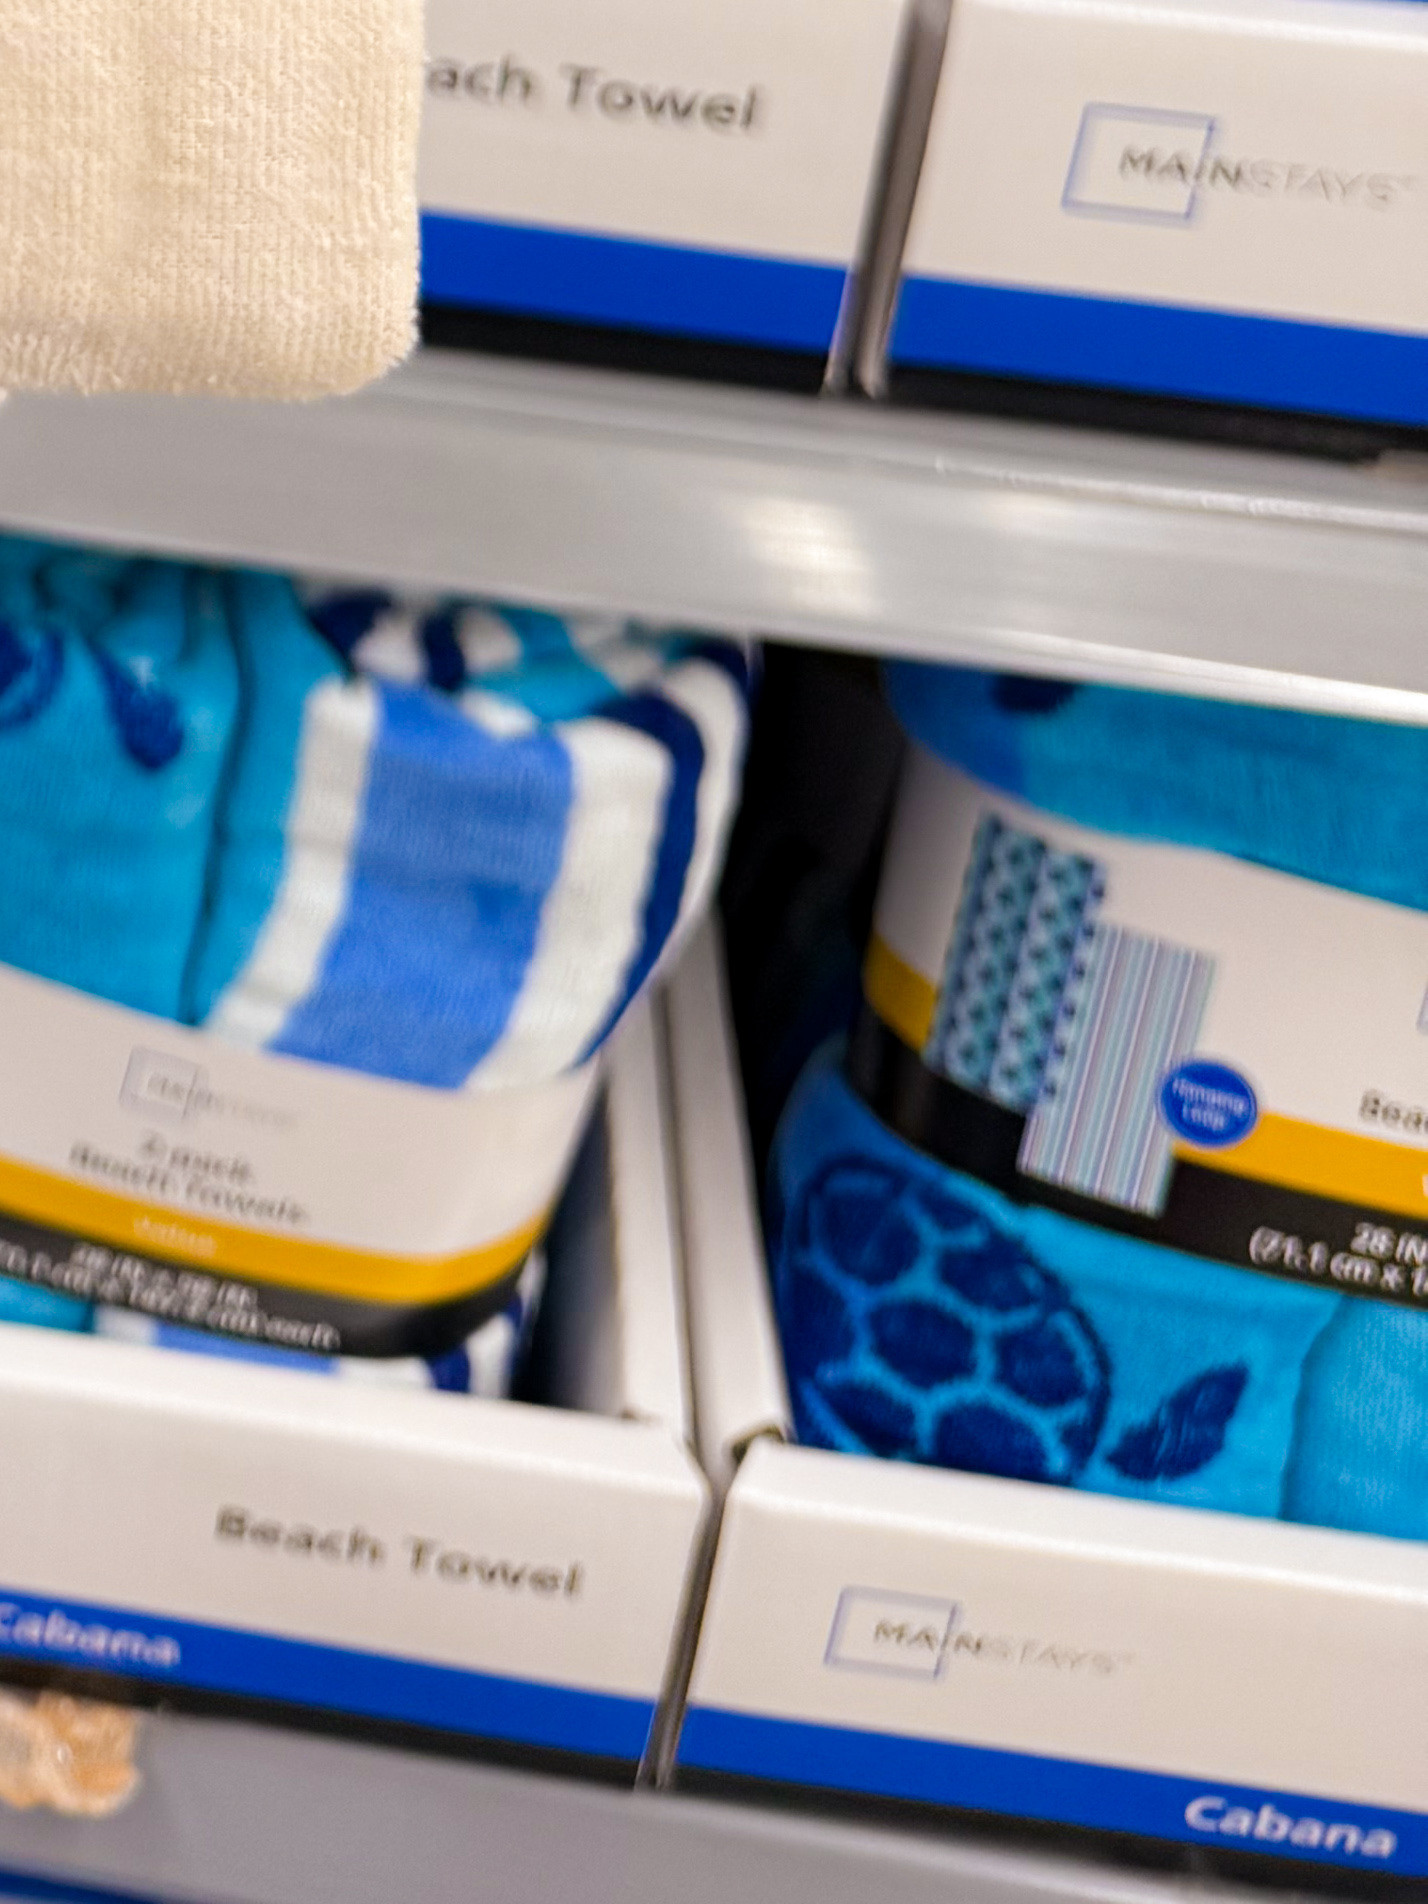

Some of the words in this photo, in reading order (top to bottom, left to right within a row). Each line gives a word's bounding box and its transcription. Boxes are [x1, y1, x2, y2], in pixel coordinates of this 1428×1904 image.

[559, 61, 758, 133] Towel
[215, 1504, 386, 1566] Beach
[406, 1534, 584, 1598] Towel
[1184, 1794, 1398, 1859] Cabana
